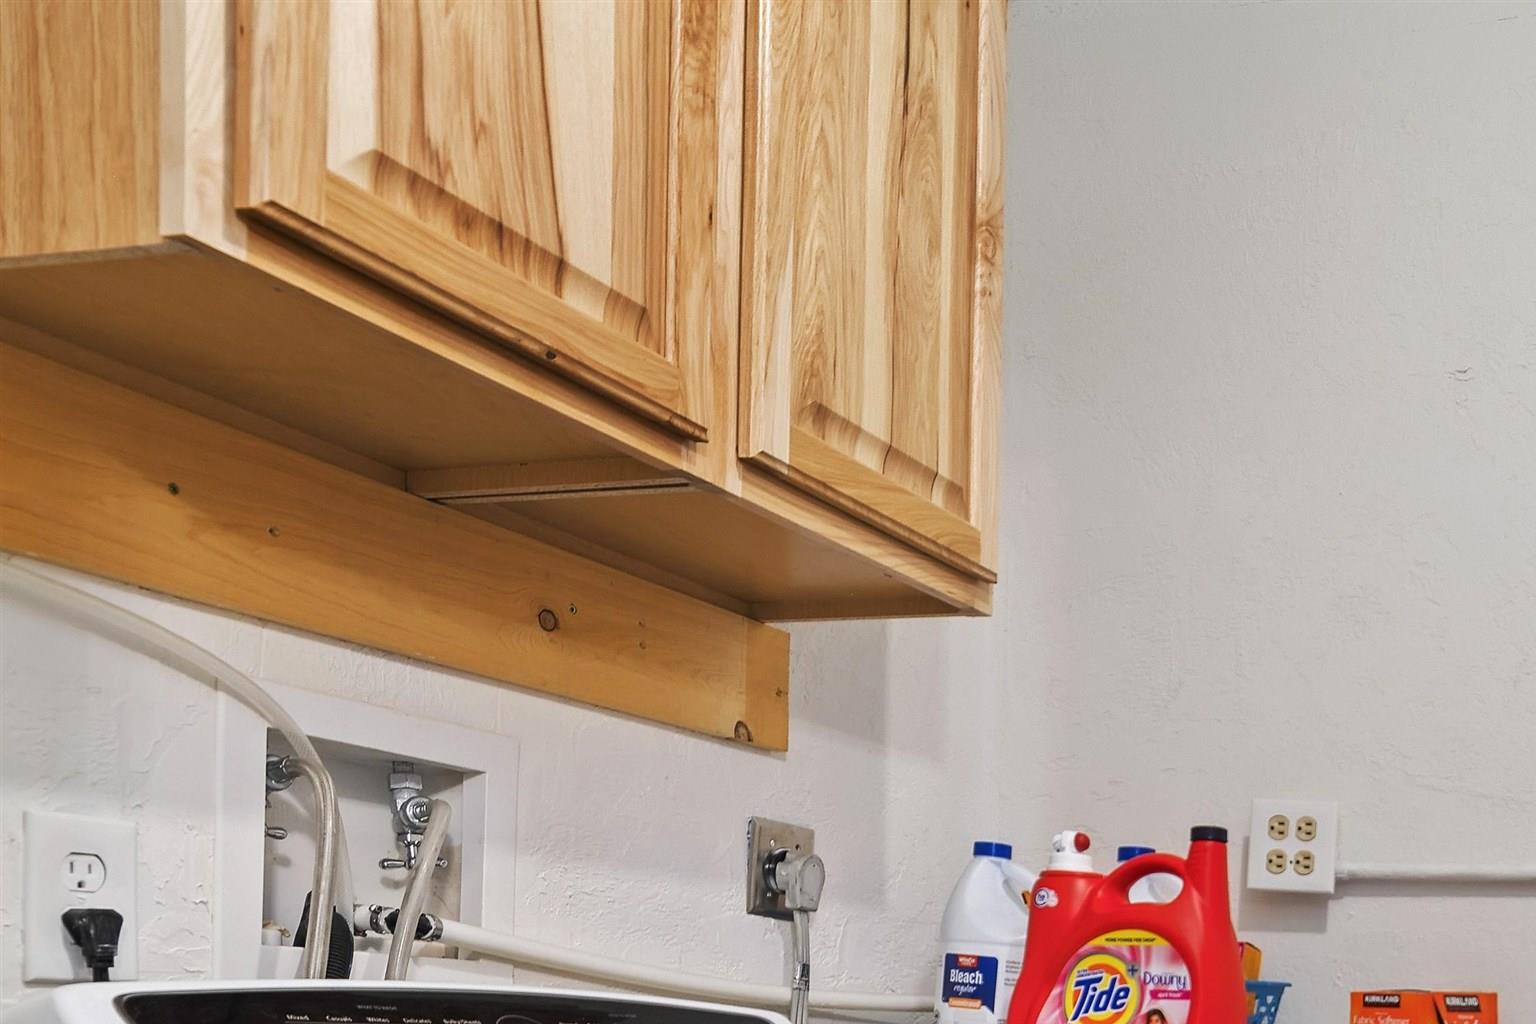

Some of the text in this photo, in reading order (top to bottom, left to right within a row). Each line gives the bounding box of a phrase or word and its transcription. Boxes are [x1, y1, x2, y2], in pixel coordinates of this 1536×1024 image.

[950, 969, 983, 984] Bleach
[1143, 970, 1187, 991] Downy
[953, 984, 977, 996] regular
[1069, 975, 1131, 1023] Tide
[1364, 995, 1400, 1003] KIRKLAND
[1353, 1015, 1376, 1024] Fabric
